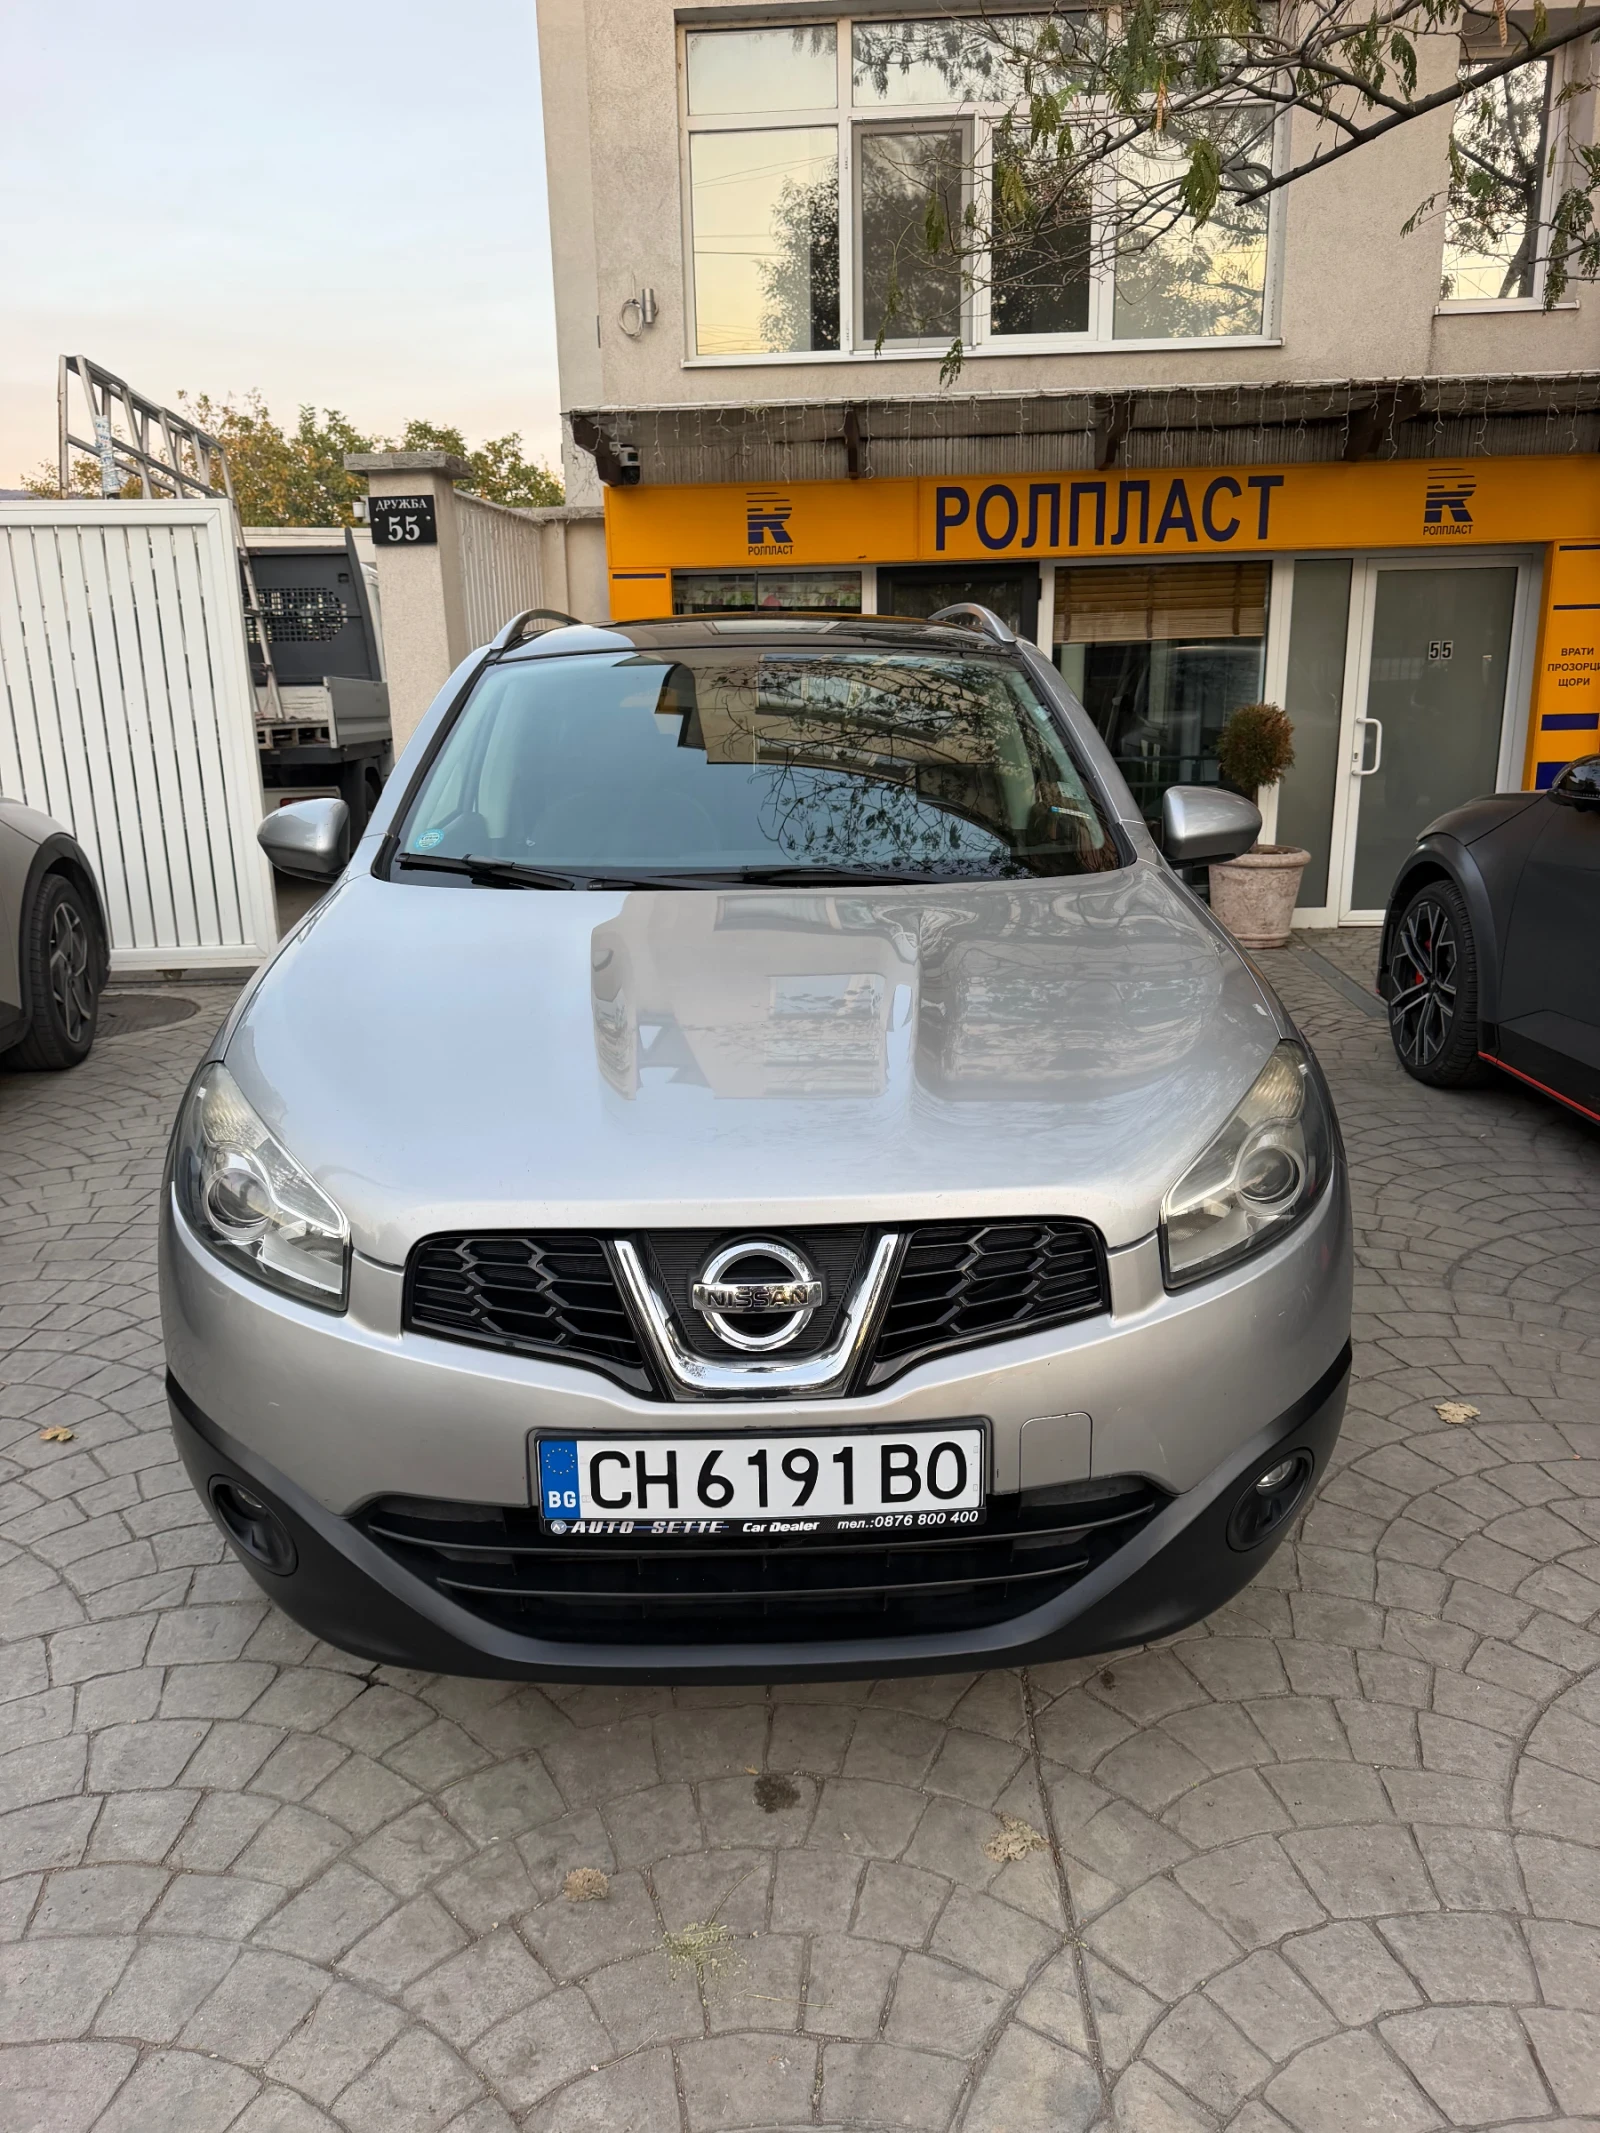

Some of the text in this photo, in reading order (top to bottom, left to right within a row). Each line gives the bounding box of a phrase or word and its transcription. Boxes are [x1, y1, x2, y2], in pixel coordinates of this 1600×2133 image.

[375, 498, 428, 512] ДРУЖБА
[936, 475, 1285, 551] РОЛПЛАСТ
[388, 515, 420, 541] 55
[1422, 524, 1474, 536] РОЛПЛАСТ
[747, 545, 794, 556] РОЛПЛАСТ
[1430, 641, 1452, 659] 55
[1560, 647, 1595, 657] ВРАТИ
[1558, 677, 1591, 688] ЩОРИ
[706, 1287, 809, 1308] NISSAN
[548, 1490, 576, 1509] BG
[917, 1512, 946, 1525] 800
[950, 1510, 979, 1523] 400
[571, 1520, 820, 1534] AUTO SETTE Car Dealer
